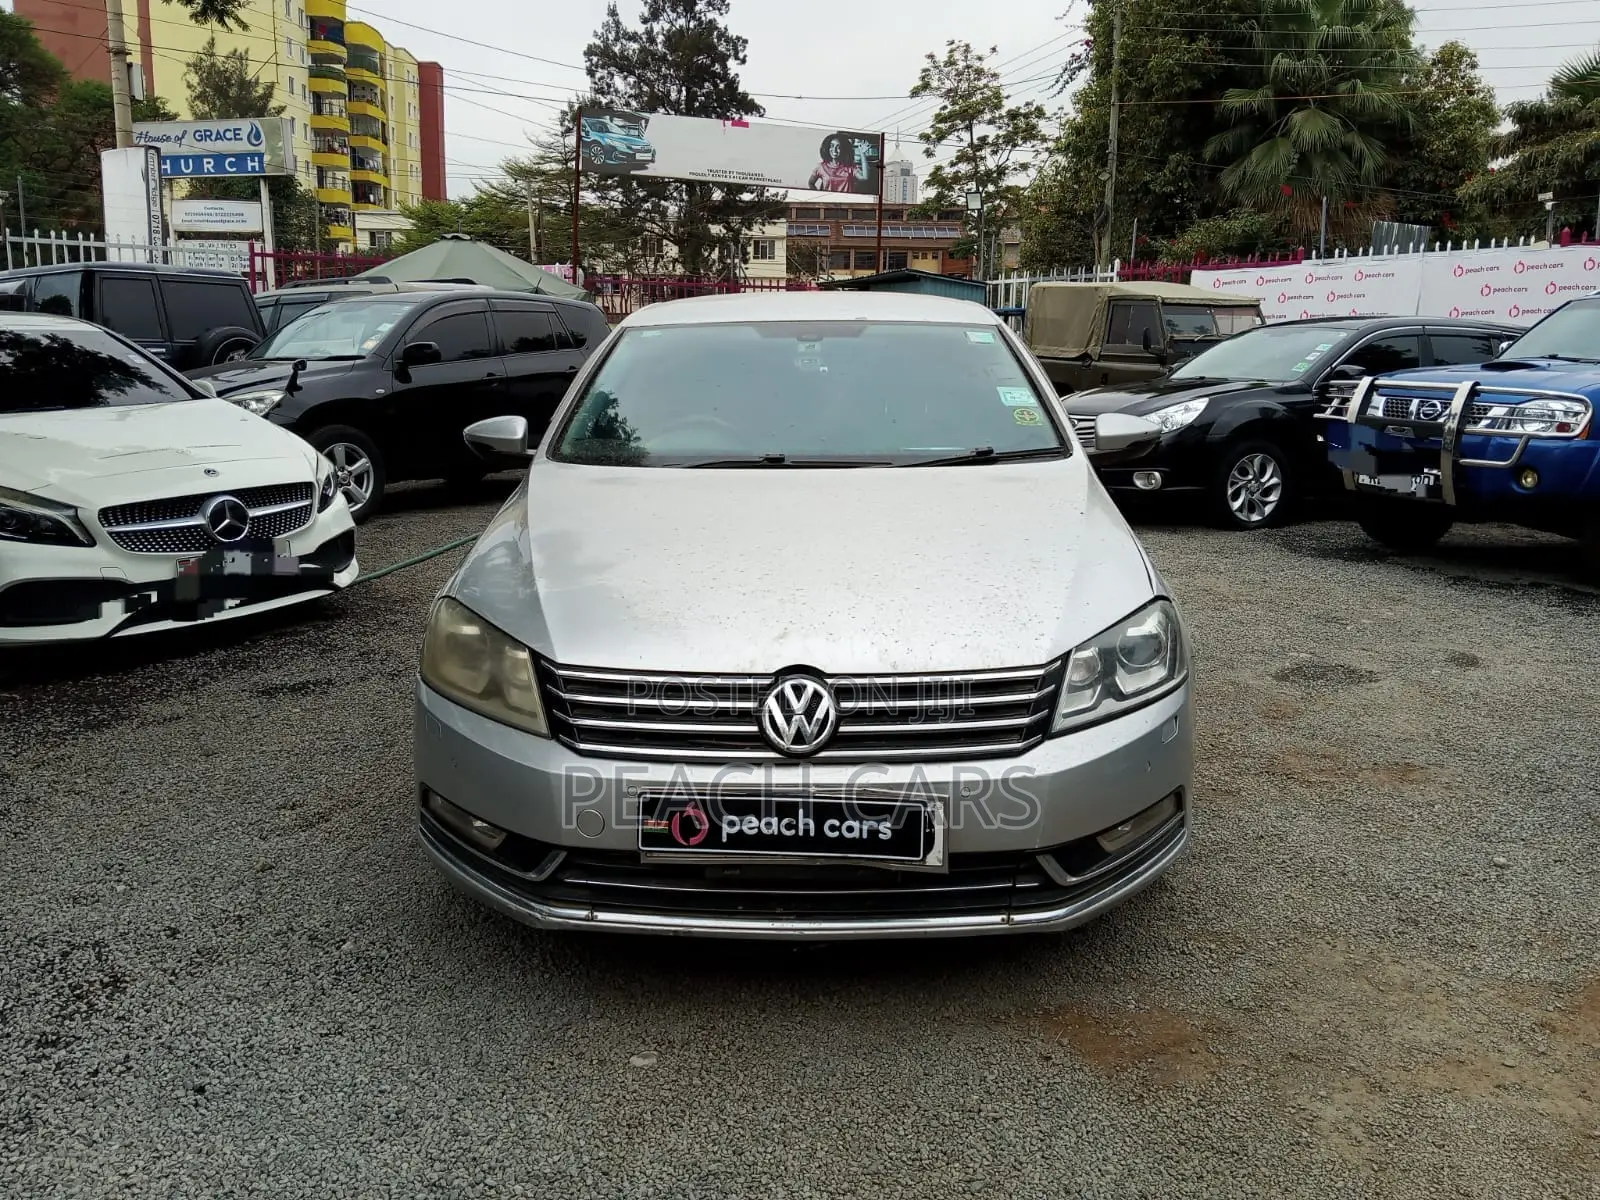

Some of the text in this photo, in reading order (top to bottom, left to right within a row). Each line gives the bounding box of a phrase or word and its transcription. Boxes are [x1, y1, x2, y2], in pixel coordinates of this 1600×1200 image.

[136, 128, 243, 148] House of GRACE
[161, 156, 260, 174] HURCH
[152, 214, 160, 235] 0718
[1486, 264, 1500, 272] cars
[1526, 262, 1548, 271] peach
[1492, 286, 1513, 294] peach
[1558, 284, 1580, 293] peach
[1460, 309, 1480, 317] peach
[1521, 307, 1542, 315] peach
[722, 808, 892, 842] peach cars
